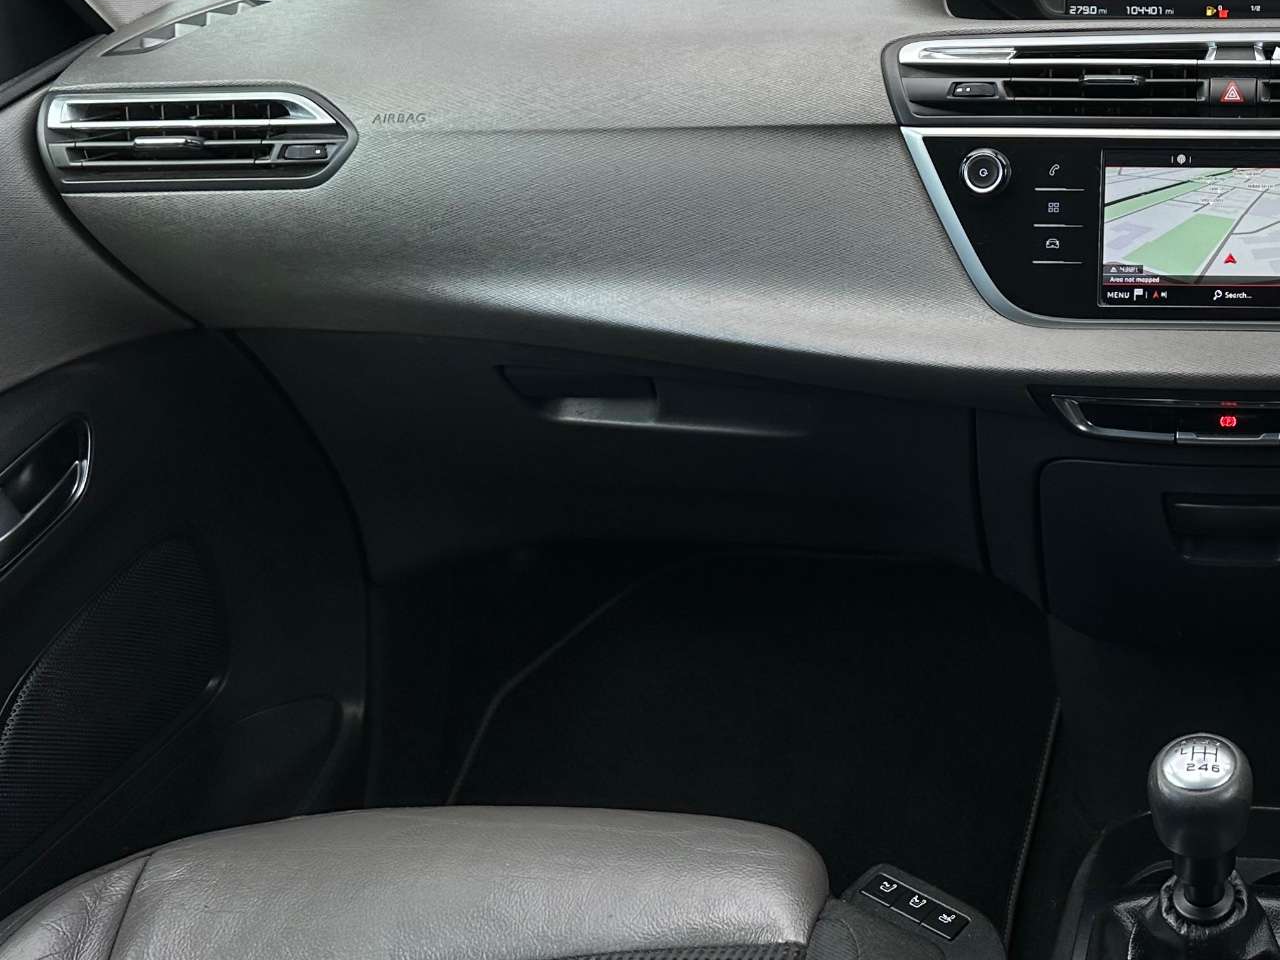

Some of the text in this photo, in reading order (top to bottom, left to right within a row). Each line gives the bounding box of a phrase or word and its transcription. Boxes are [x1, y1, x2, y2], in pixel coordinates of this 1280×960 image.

[1098, 7, 1108, 15] mi
[1126, 5, 1175, 15] 104401 mi
[371, 112, 427, 124] AIRBAG
[1136, 276, 1160, 284] mapped
[1106, 291, 1130, 299] MENU
